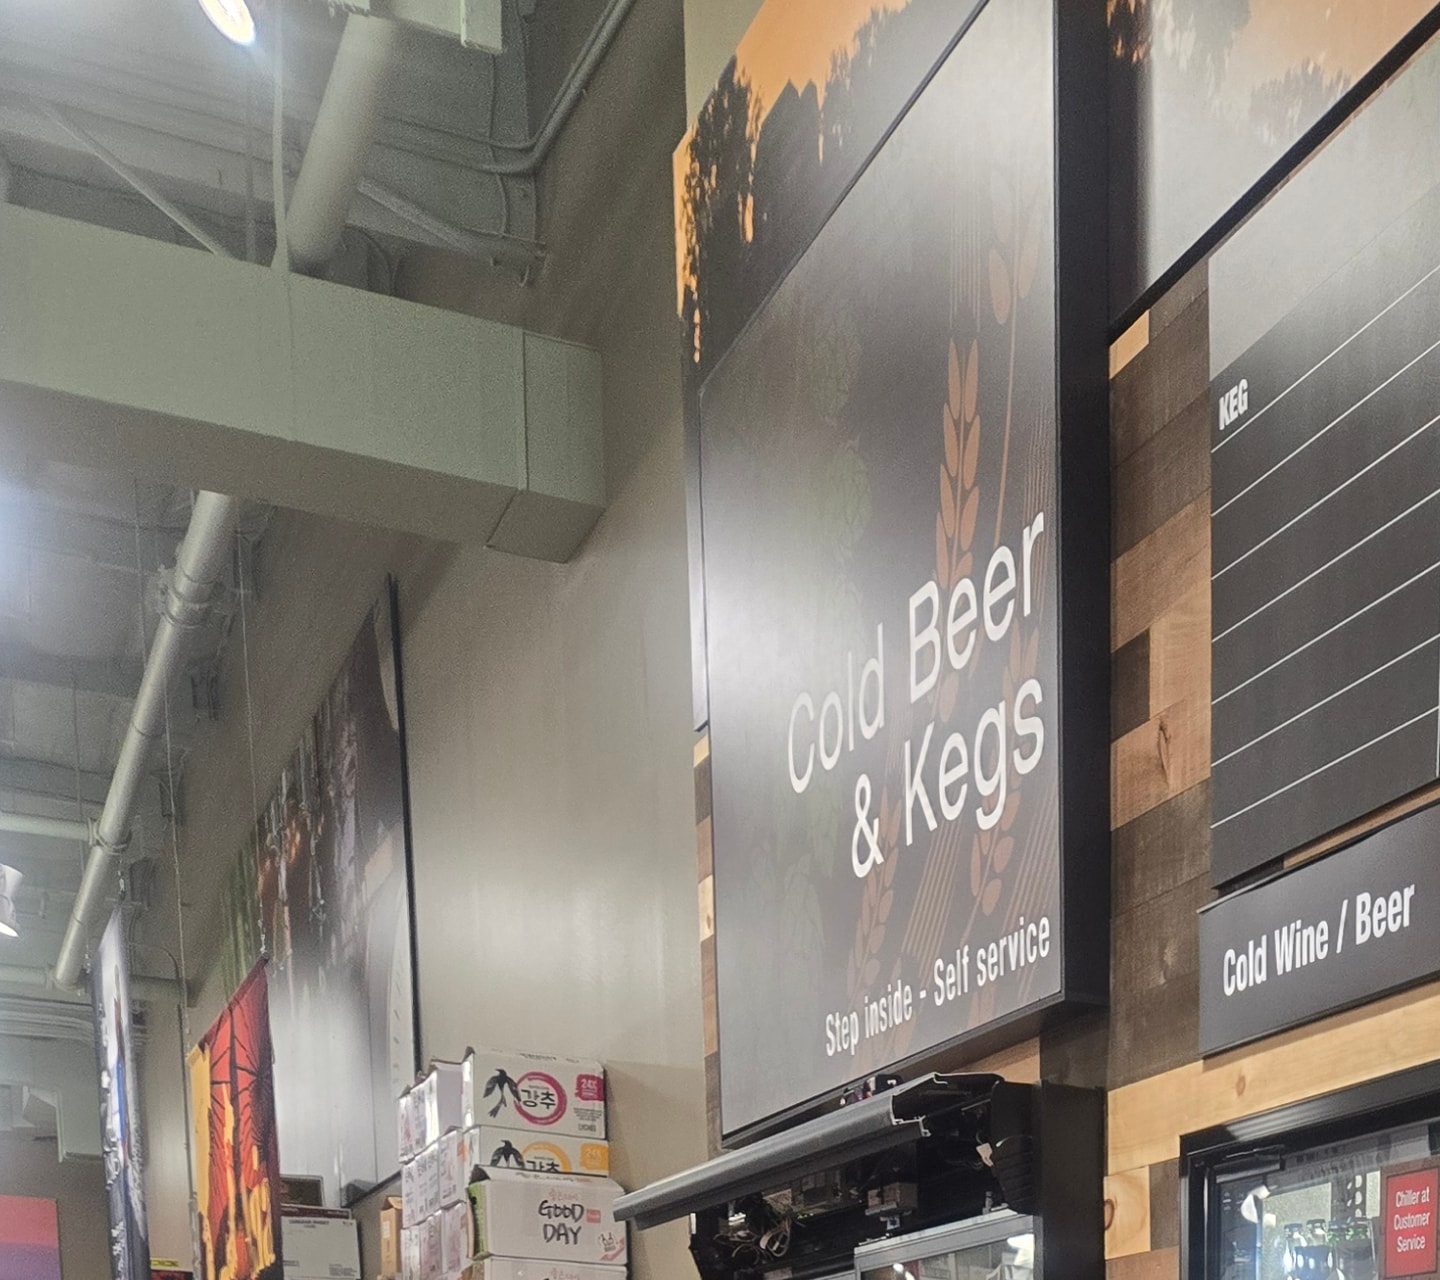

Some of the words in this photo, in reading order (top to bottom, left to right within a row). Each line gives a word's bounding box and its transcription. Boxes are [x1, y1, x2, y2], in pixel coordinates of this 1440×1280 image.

[1219, 379, 1248, 430] KEG
[788, 624, 885, 793] Cold
[908, 512, 1045, 704] Beer
[850, 773, 885, 878] &
[904, 678, 1045, 846] Kegs
[1223, 947, 1267, 997] Cold
[1274, 924, 1329, 975] Wine
[1336, 900, 1348, 953] /
[1356, 884, 1415, 945] Beer
[825, 1008, 859, 1057] Step
[865, 976, 913, 1026] inside
[933, 942, 970, 1007] Self
[976, 916, 1051, 975] service
[538, 1200, 585, 1223] GOOD
[1395, 1190, 1419, 1207] Chiller
[1421, 1186, 1430, 1203] at
[543, 1223, 582, 1245] DAY
[1394, 1210, 1430, 1231] Customer
[1397, 1235, 1426, 1252] Service
